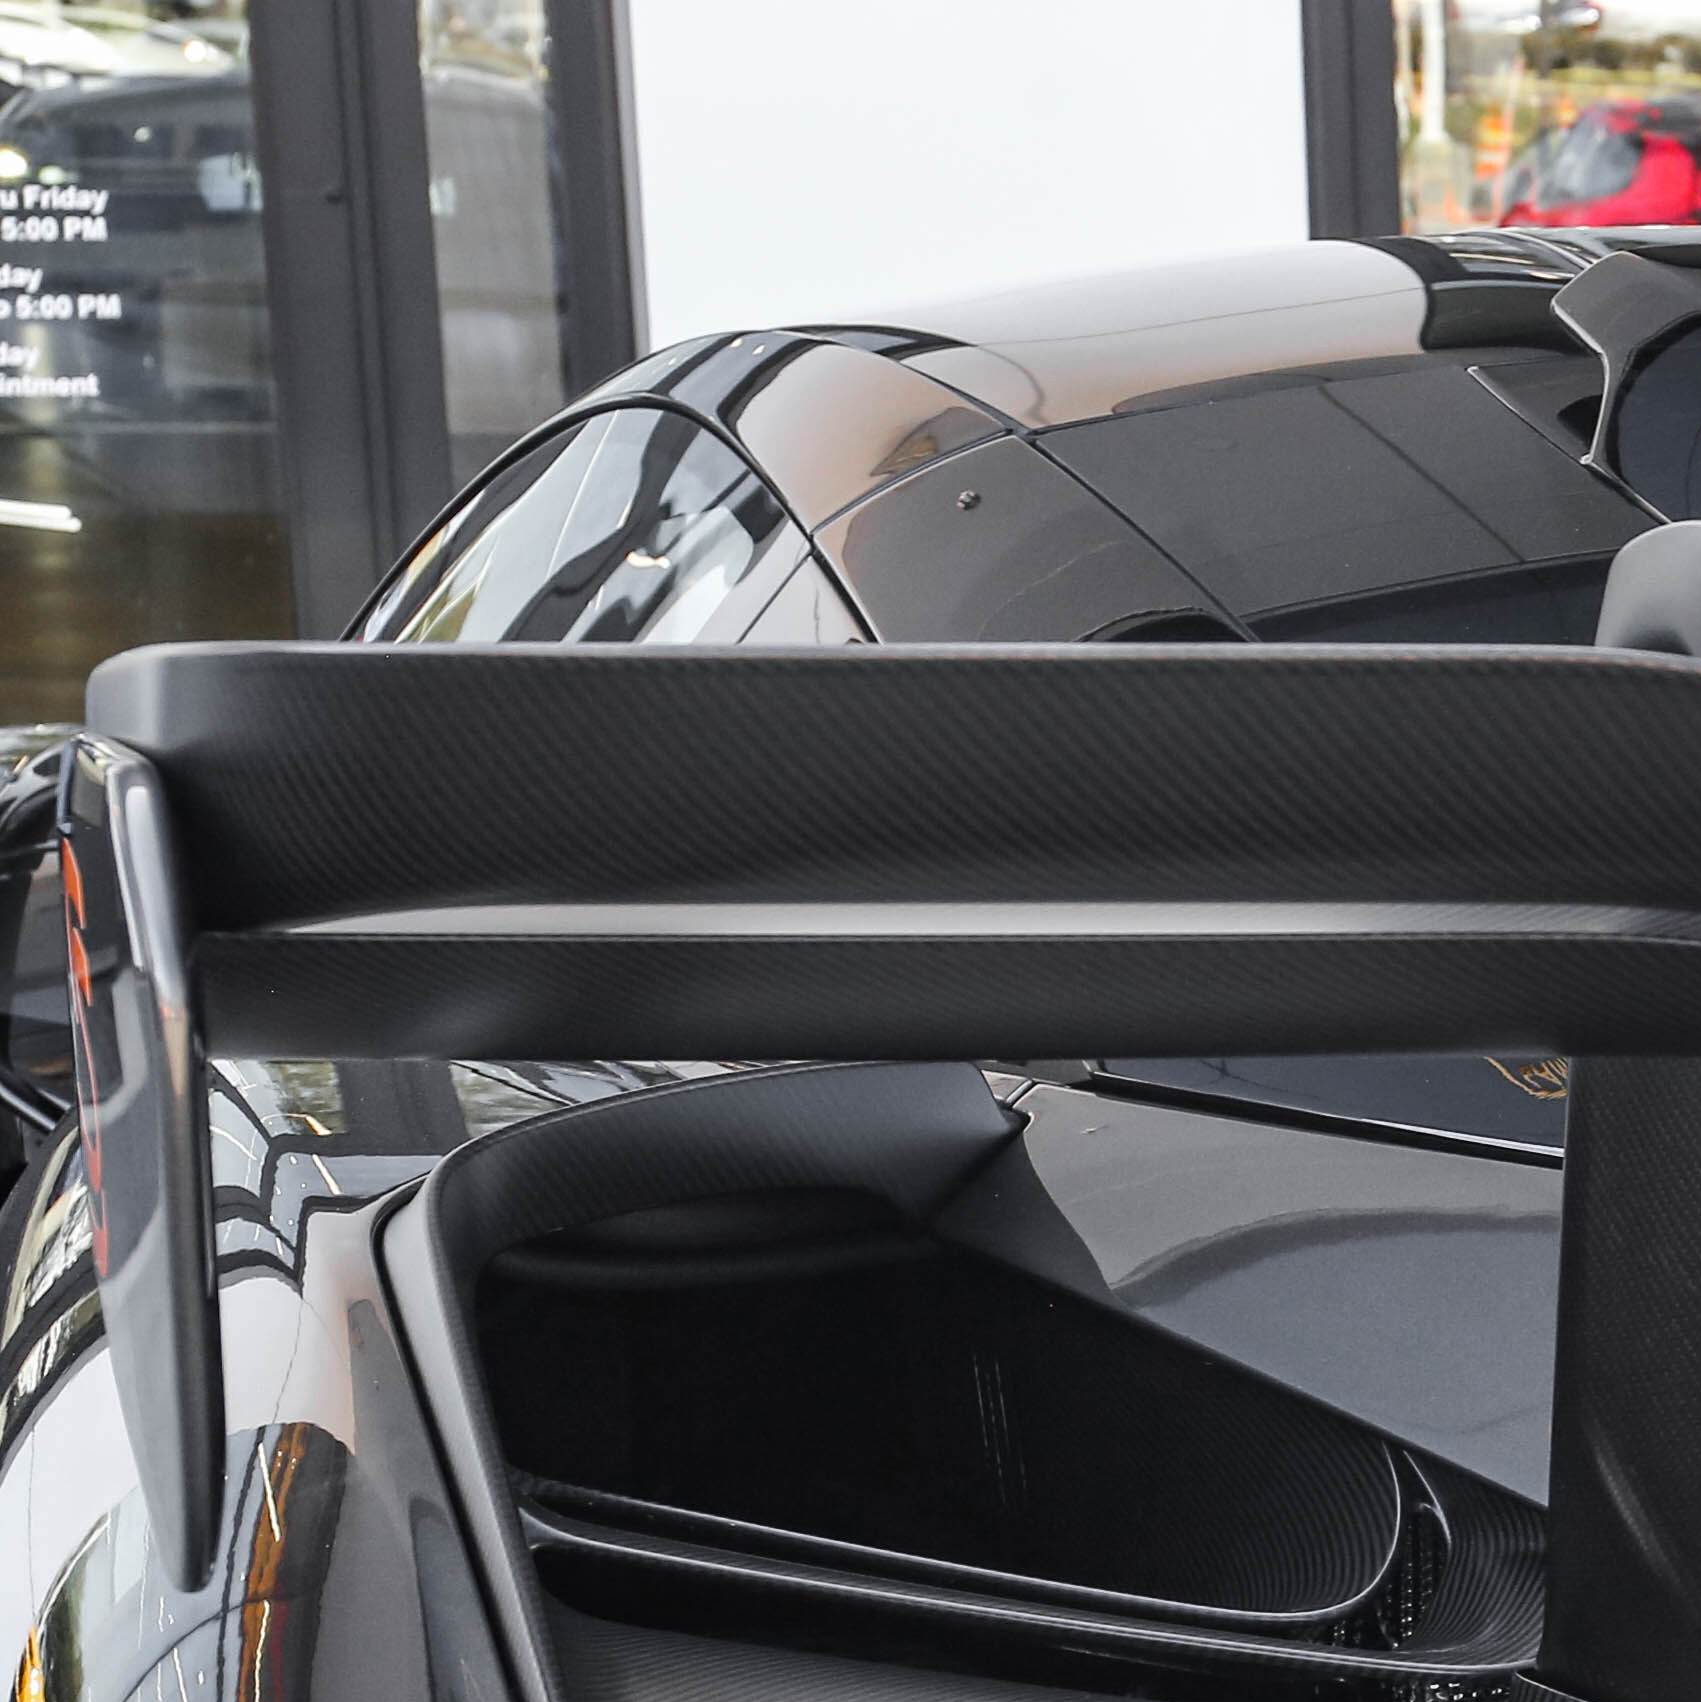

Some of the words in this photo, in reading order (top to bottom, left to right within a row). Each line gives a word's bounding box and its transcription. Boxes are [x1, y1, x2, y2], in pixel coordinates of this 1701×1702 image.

[22, 184, 108, 215] Friday
[1, 216, 59, 242] 5:00
[63, 216, 108, 242] PM
[16, 294, 73, 320] 5:00
[77, 294, 122, 320] PM
